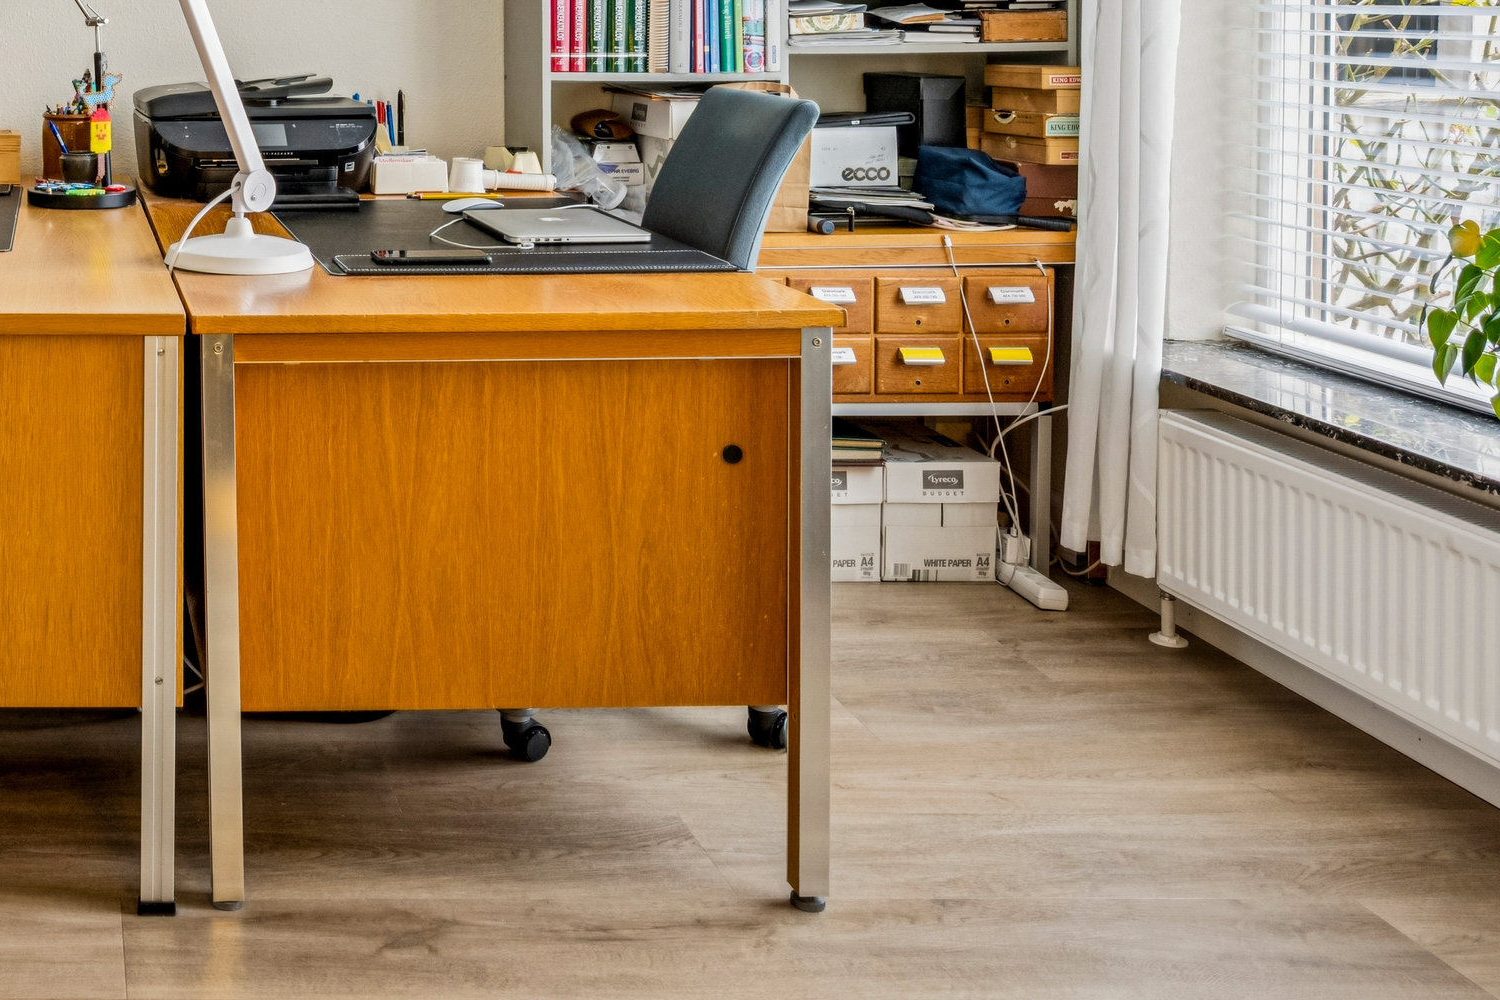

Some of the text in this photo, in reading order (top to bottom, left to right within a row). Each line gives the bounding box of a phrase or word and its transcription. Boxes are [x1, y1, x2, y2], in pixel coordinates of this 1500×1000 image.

[841, 167, 890, 181] ecco
[932, 475, 956, 484] Lyreco
[861, 557, 873, 566] A4
[924, 559, 971, 567] WHITE PAPER
[977, 557, 989, 566] A4
